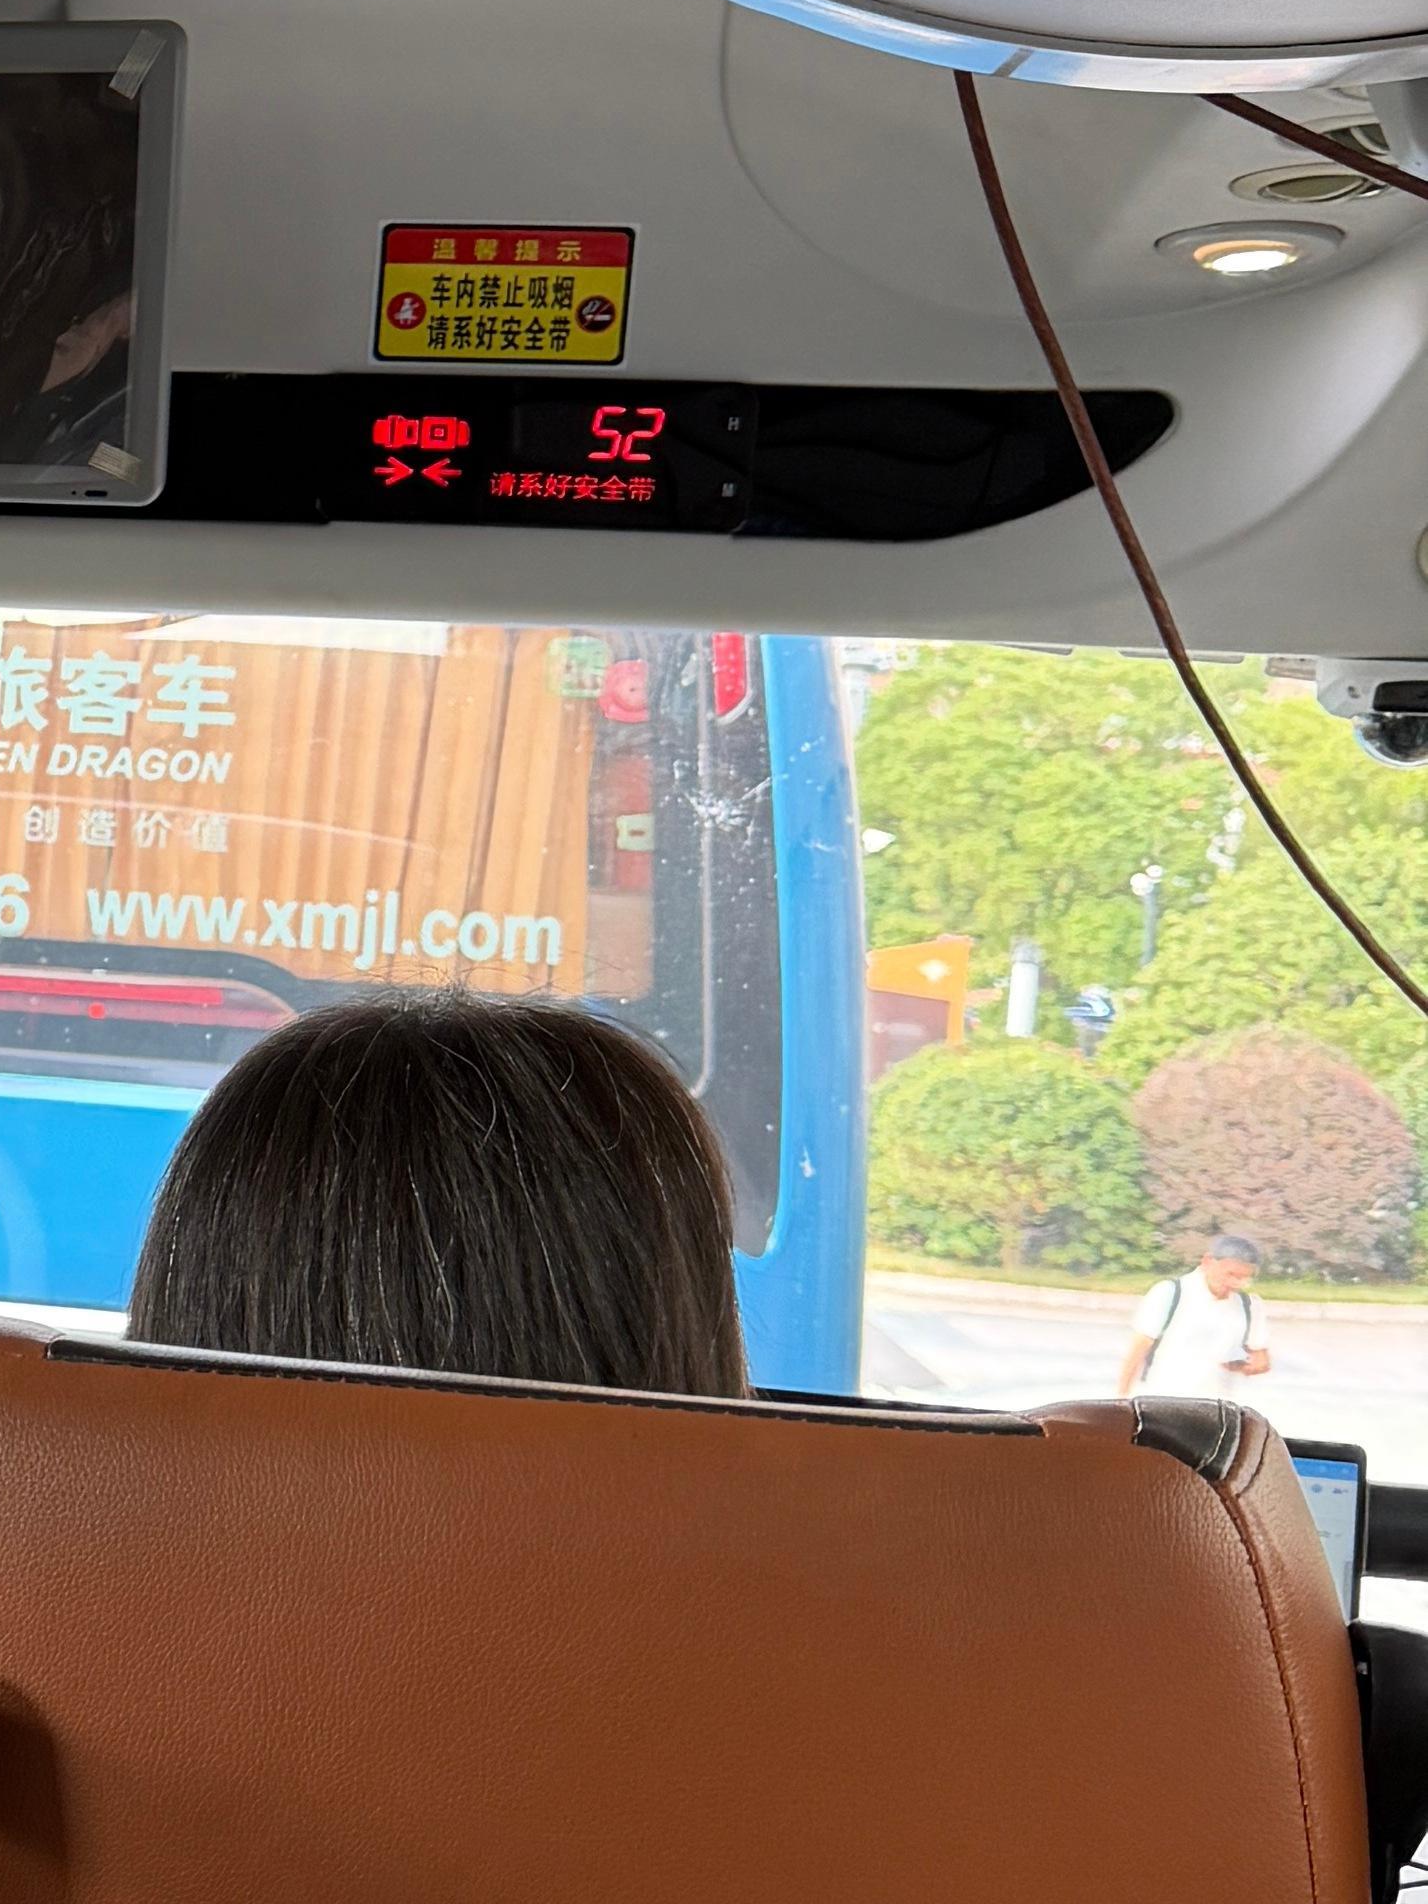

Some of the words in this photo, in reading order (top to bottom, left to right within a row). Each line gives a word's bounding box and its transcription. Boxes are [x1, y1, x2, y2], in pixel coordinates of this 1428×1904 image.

[432, 238, 582, 263] 温馨提示
[429, 273, 576, 311] 车内禁止吸烟
[426, 315, 572, 353] 请系好安全带
[588, 405, 666, 461] 52
[490, 471, 657, 502] 请系好安全带
[46, 743, 235, 785] DRAGON
[24, 804, 231, 854] 创造价值
[85, 888, 564, 971] www.xmjl.com
